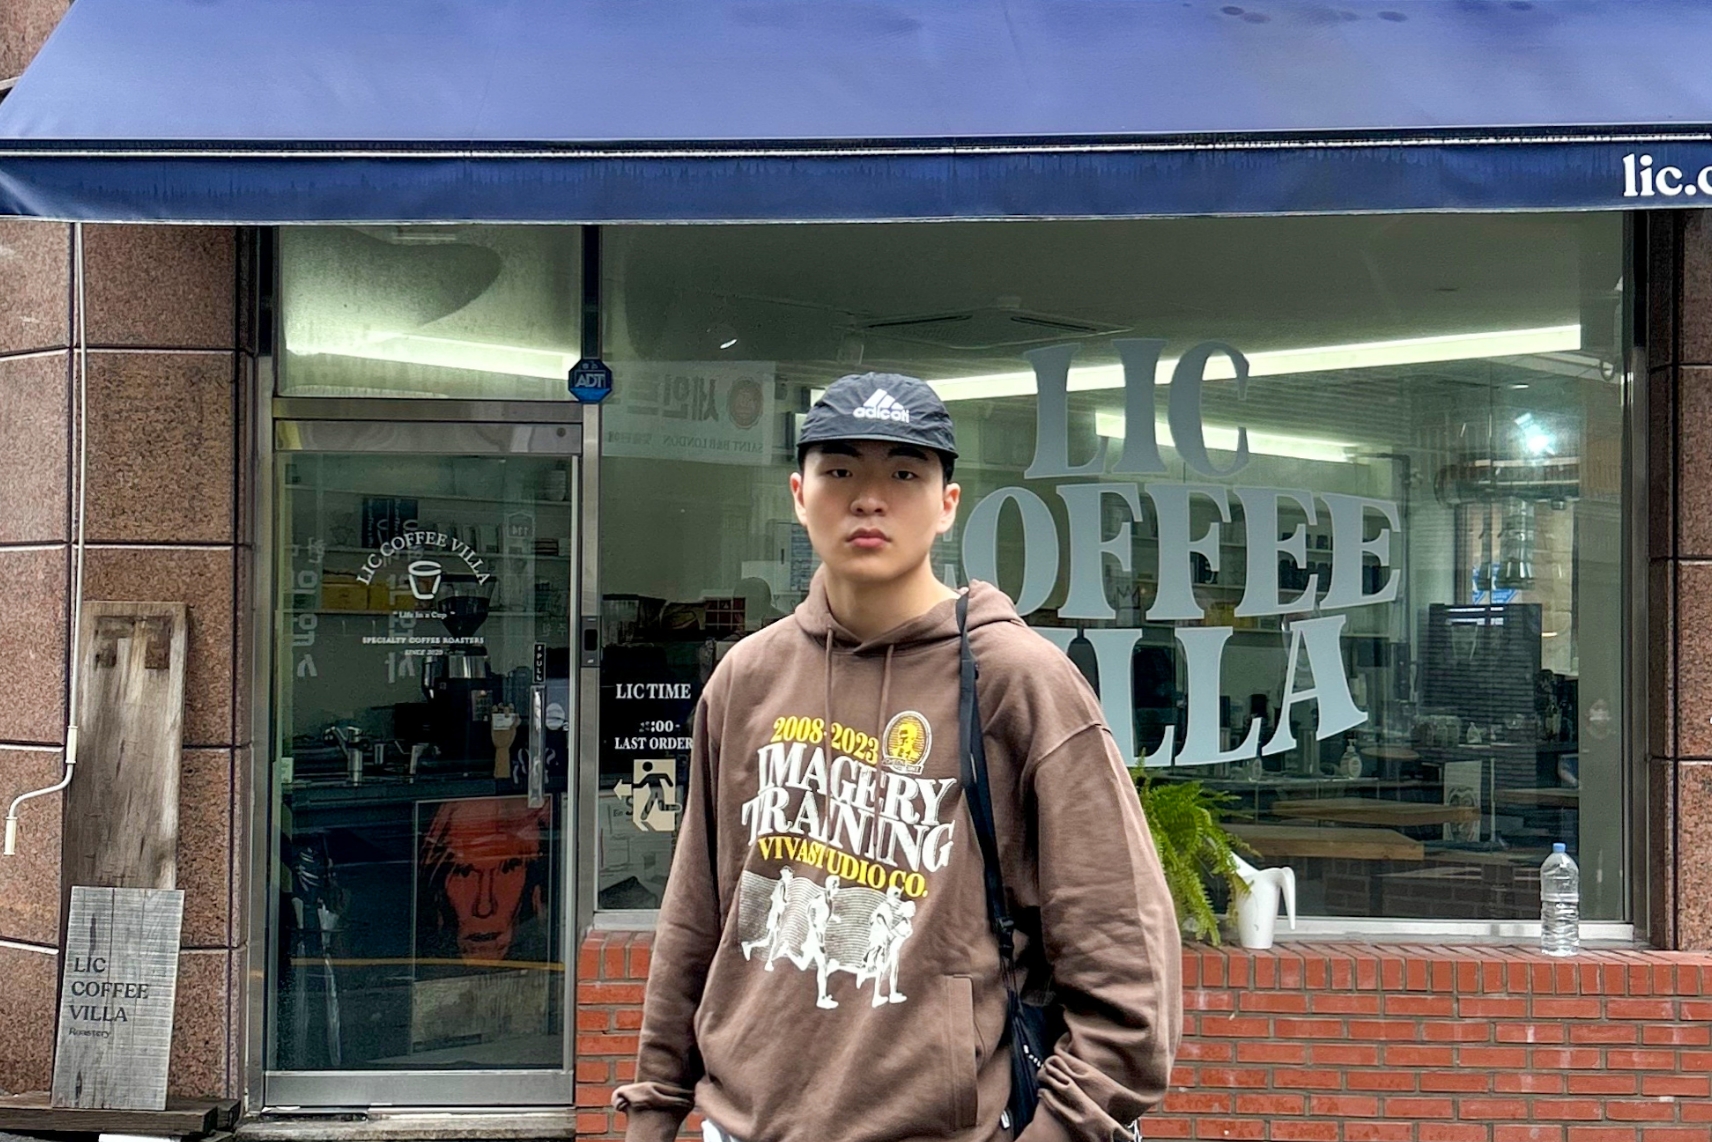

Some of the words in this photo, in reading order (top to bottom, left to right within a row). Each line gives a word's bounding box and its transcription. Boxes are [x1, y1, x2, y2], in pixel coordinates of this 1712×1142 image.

[574, 373, 606, 388] ADT
[1023, 338, 1251, 479] LIC
[356, 553, 383, 586] LIC
[380, 531, 449, 557] COFFEE
[450, 537, 491, 586] VILLA
[943, 483, 1402, 621] OFFEE
[362, 636, 407, 644] SPECIALTY
[408, 636, 441, 644] COFFEE
[442, 636, 485, 644] ROASTERS
[616, 683, 645, 700] LIC
[646, 683, 692, 700] TIME
[1030, 615, 1368, 768] LLA
[614, 736, 647, 750] LAST
[649, 736, 693, 750] ORDER
[757, 741, 958, 827] IMAGERY
[741, 786, 957, 874] TRAINING
[758, 836, 887, 889] VIVASTUDIO
[888, 868, 930, 899] CO.
[73, 957, 107, 974] LIC
[70, 980, 150, 1000] COFFEE
[68, 1004, 128, 1023] VILLA
[68, 1026, 111, 1039] Roastery
